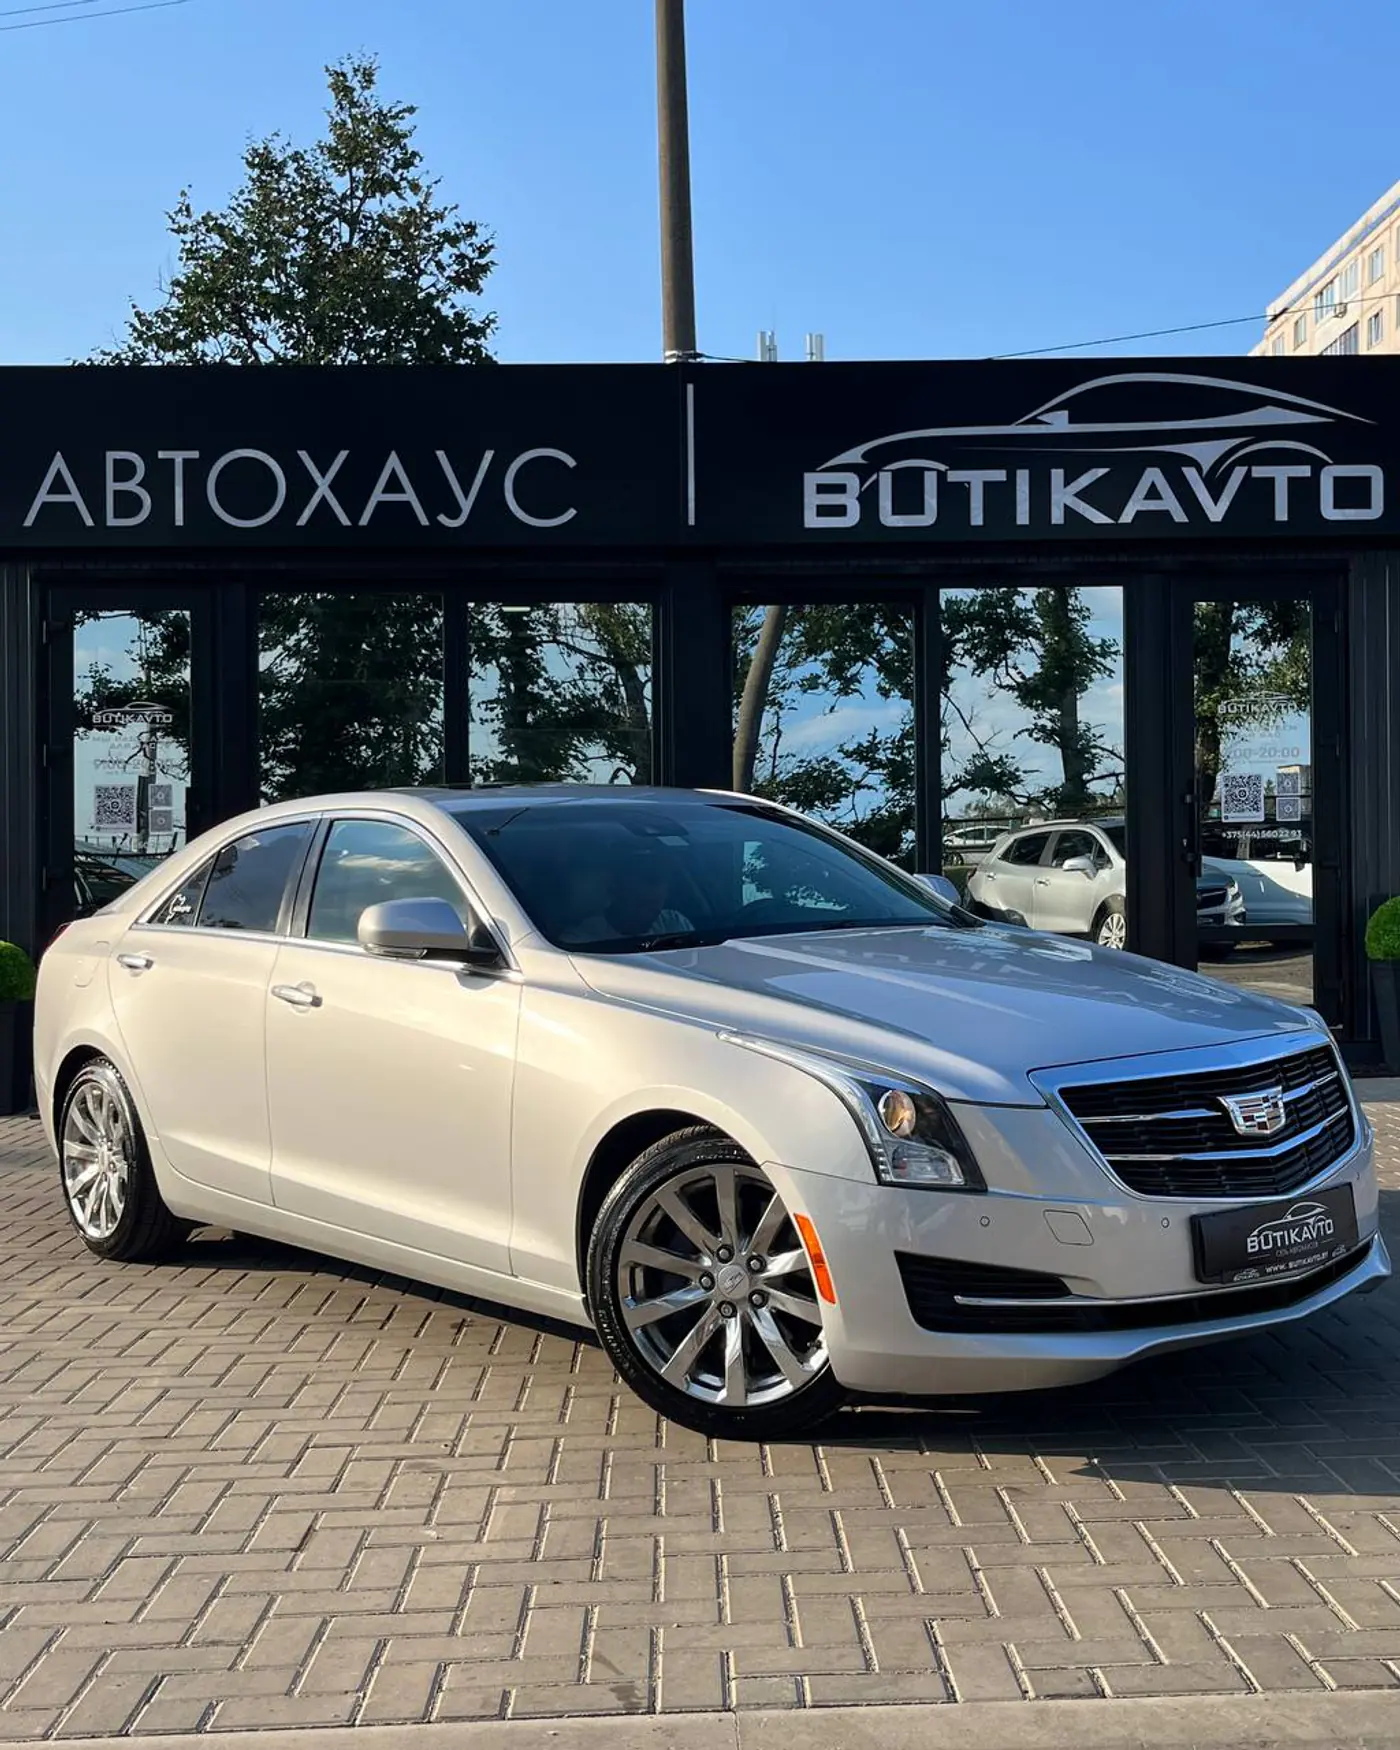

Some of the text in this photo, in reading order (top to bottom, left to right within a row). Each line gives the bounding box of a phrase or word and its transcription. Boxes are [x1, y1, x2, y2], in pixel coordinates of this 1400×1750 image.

[23, 447, 578, 528] АВТОХАУС
[803, 464, 1385, 529] BUTIKAVTO
[92, 713, 173, 724] BUTIKAVTO
[1217, 702, 1298, 715] BUTIKAVTO
[1246, 1219, 1334, 1253] BUTIKAVTO
